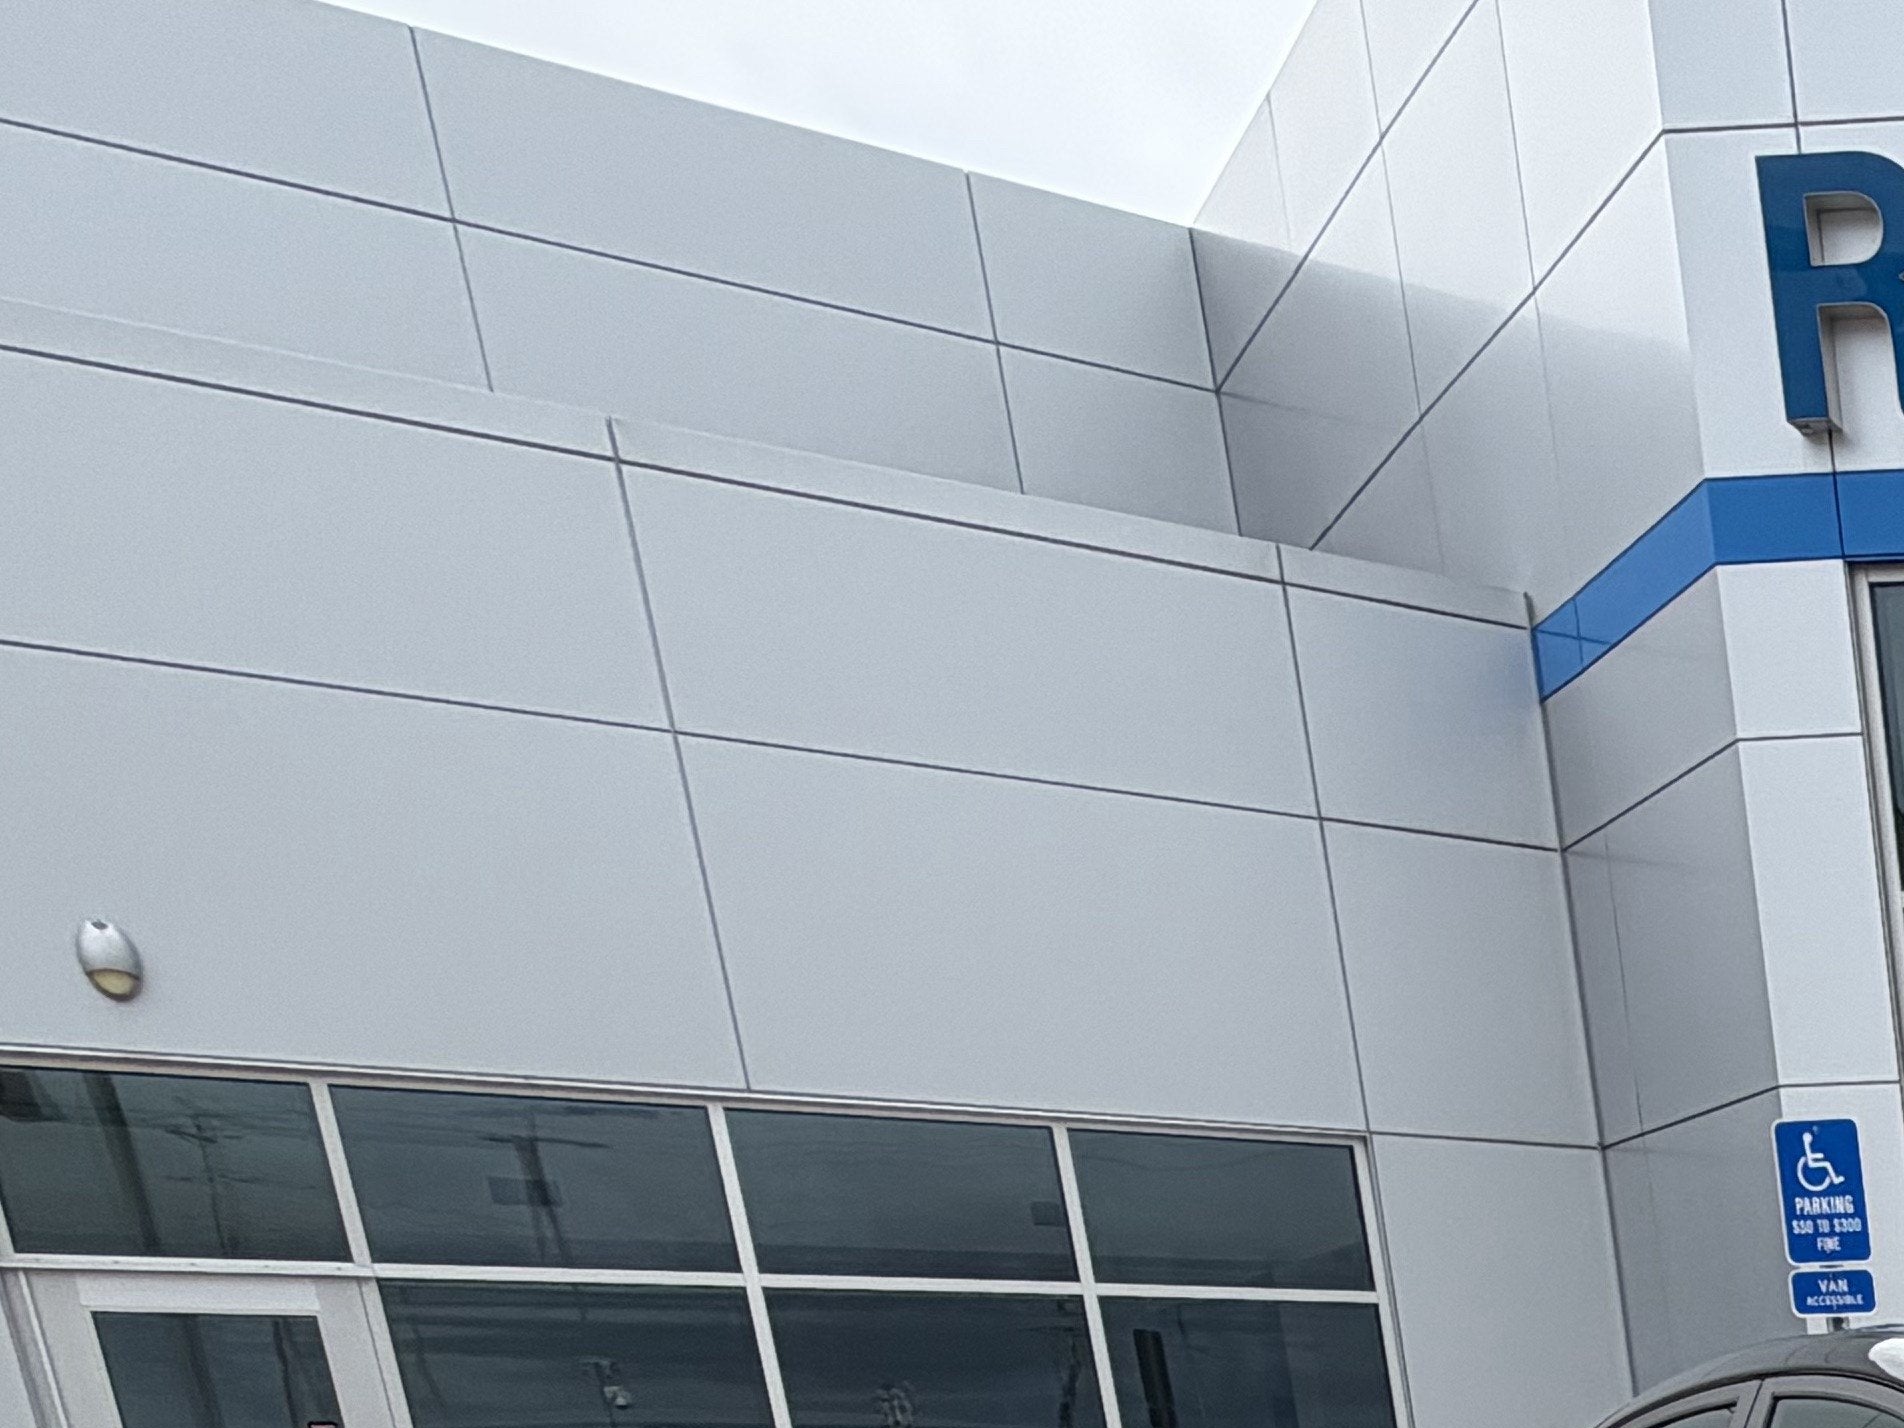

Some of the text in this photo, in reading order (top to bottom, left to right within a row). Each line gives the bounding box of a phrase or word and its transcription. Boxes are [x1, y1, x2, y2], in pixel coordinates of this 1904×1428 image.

[1795, 1195, 1855, 1215] PARKING
[1817, 1236, 1841, 1251] FINE
[1818, 1279, 1848, 1293] VAN
[1806, 1294, 1864, 1307] ACCESSIBLE
